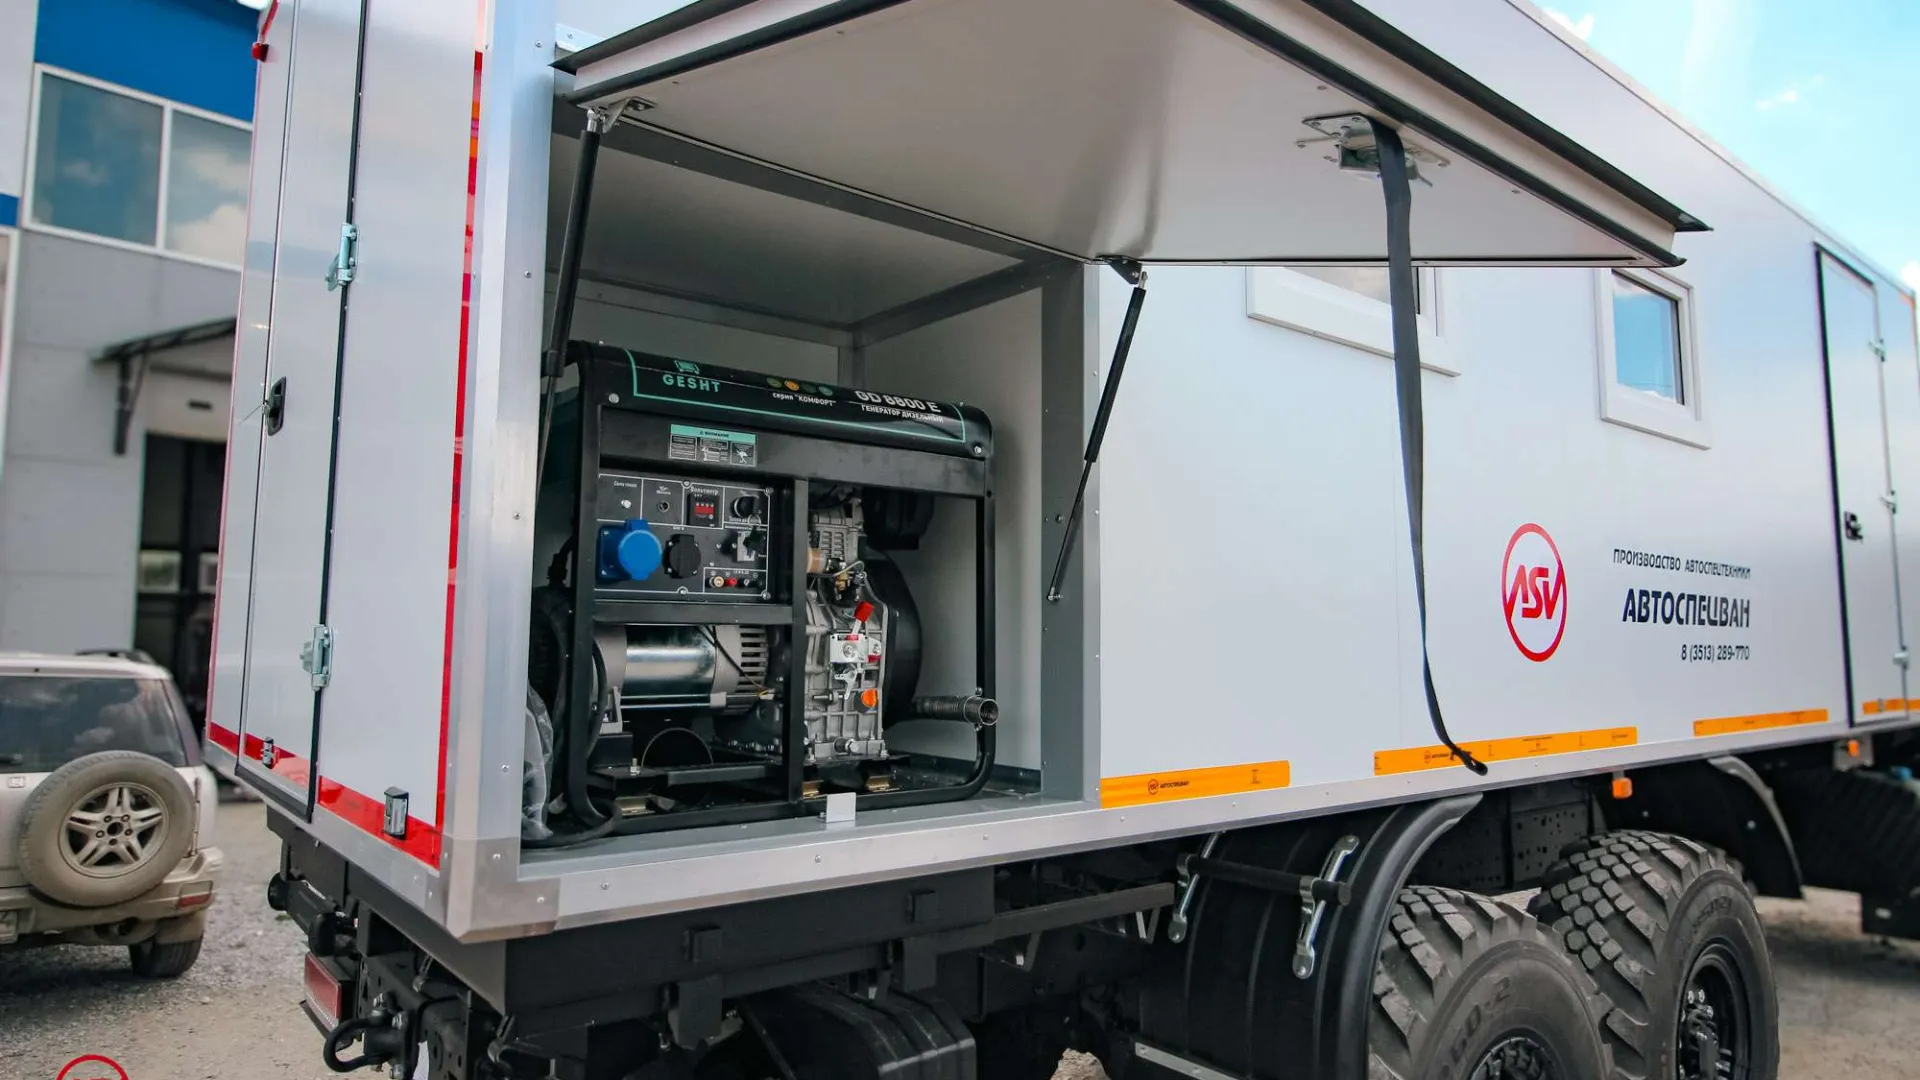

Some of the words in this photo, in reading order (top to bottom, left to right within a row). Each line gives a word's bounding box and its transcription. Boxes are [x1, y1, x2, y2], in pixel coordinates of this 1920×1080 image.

[662, 374, 720, 393] GESHT
[772, 392, 794, 400] серия
[854, 390, 882, 403] GD
[926, 401, 942, 413] E
[861, 404, 900, 416] ГЕНЕРАТОР
[901, 411, 944, 423] ДИЗЕЛЬНЫЙ
[1613, 548, 1681, 571] ПРОИЗВОДСТВО
[1684, 558, 1751, 580] АВТОСПЕЦТЕХНИКИ
[1622, 588, 1750, 628] АВТОСПЕЦВАН
[1681, 644, 1687, 661] 8
[1689, 644, 1715, 664] (3513)
[1716, 644, 1750, 662] 289-770
